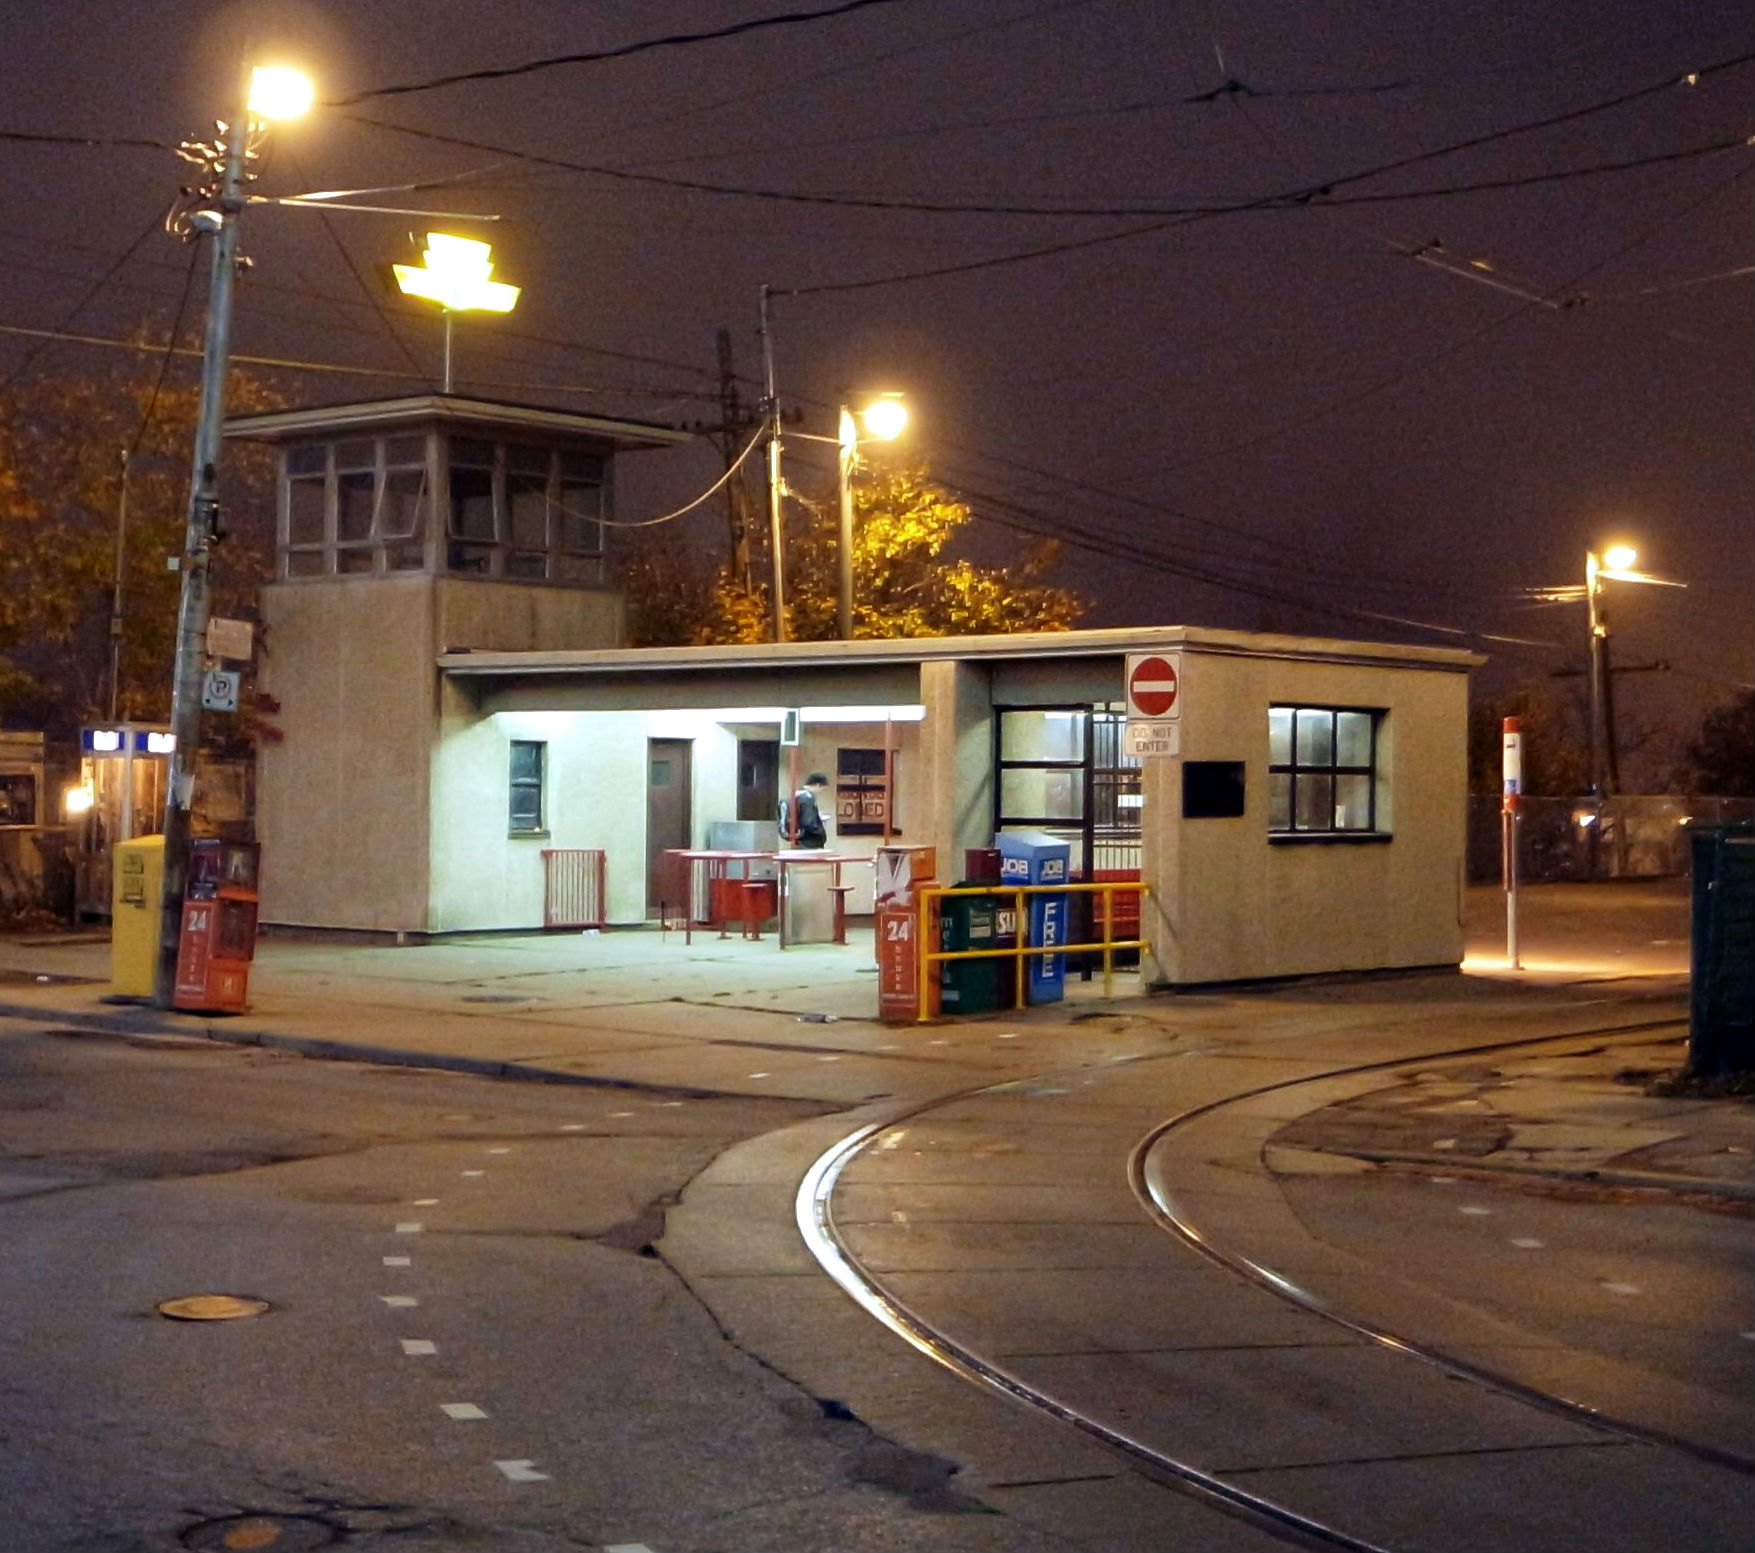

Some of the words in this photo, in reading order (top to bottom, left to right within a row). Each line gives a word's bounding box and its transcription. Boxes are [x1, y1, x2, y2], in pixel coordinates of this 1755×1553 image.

[1132, 727, 1149, 739] DO
[1152, 727, 1173, 739] NOT
[1135, 741, 1169, 753] ENTER
[187, 910, 207, 931] 24
[996, 911, 1024, 934] SU
[888, 921, 909, 942] 24
[1042, 902, 1057, 978] FREE
